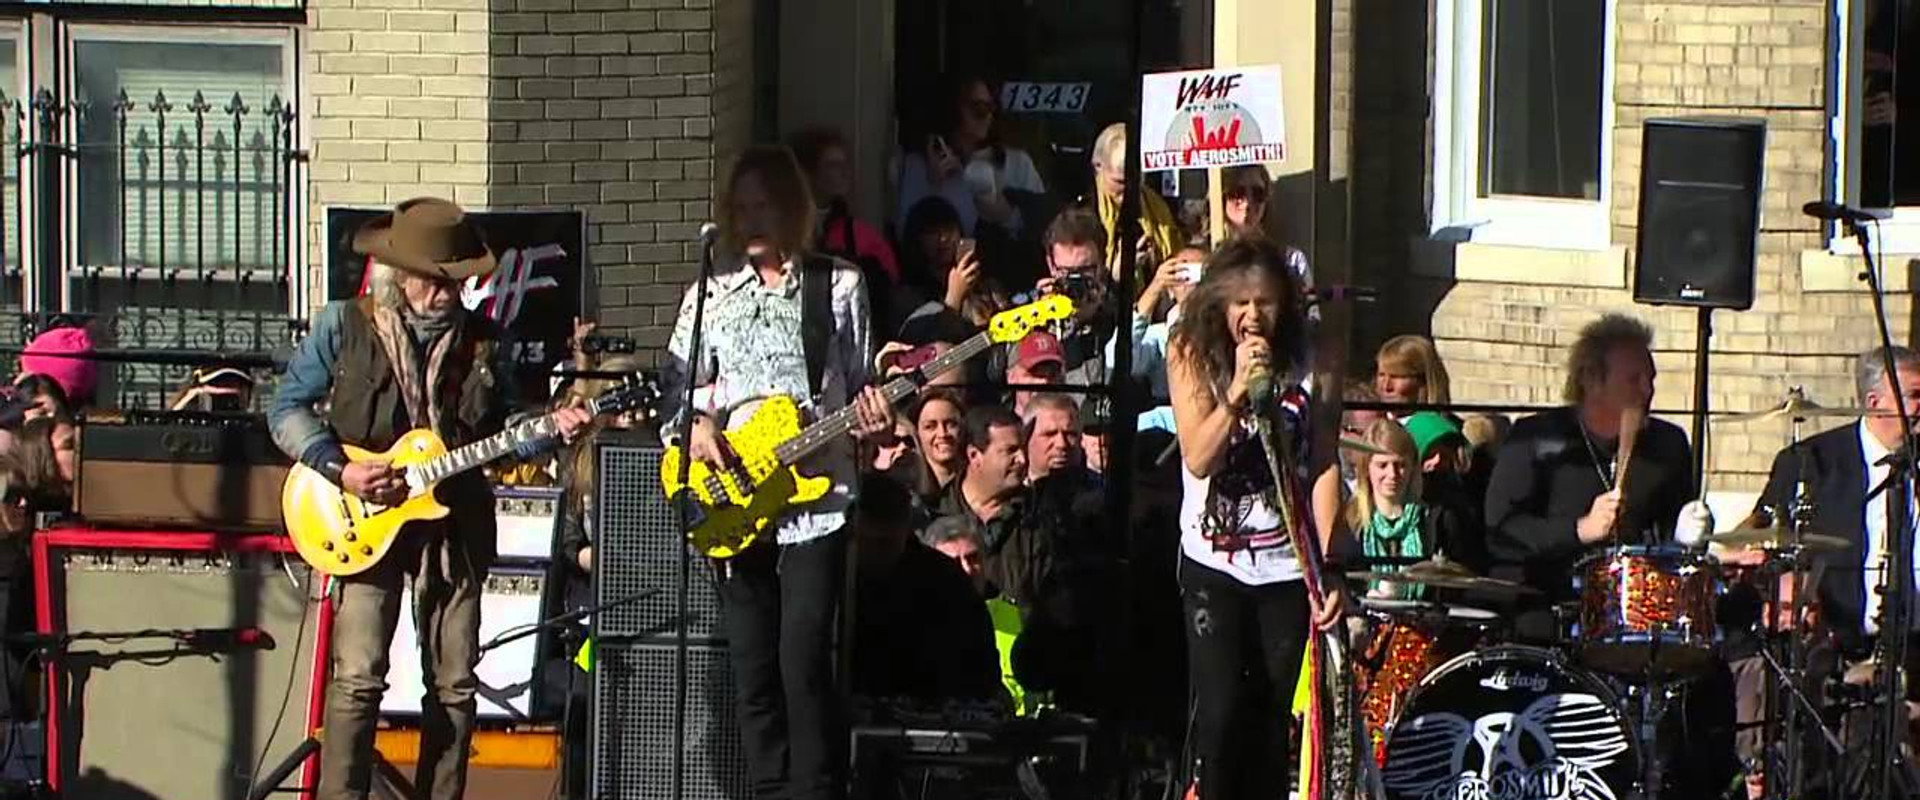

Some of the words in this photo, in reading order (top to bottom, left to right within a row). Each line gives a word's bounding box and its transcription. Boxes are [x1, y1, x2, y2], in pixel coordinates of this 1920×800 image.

[1007, 84, 1087, 111] 1343
[1175, 73, 1244, 111] WAAF
[1146, 151, 1183, 168] VOTE
[1190, 143, 1284, 166] AEROSMITH!
[1479, 665, 1549, 692] Ludwig
